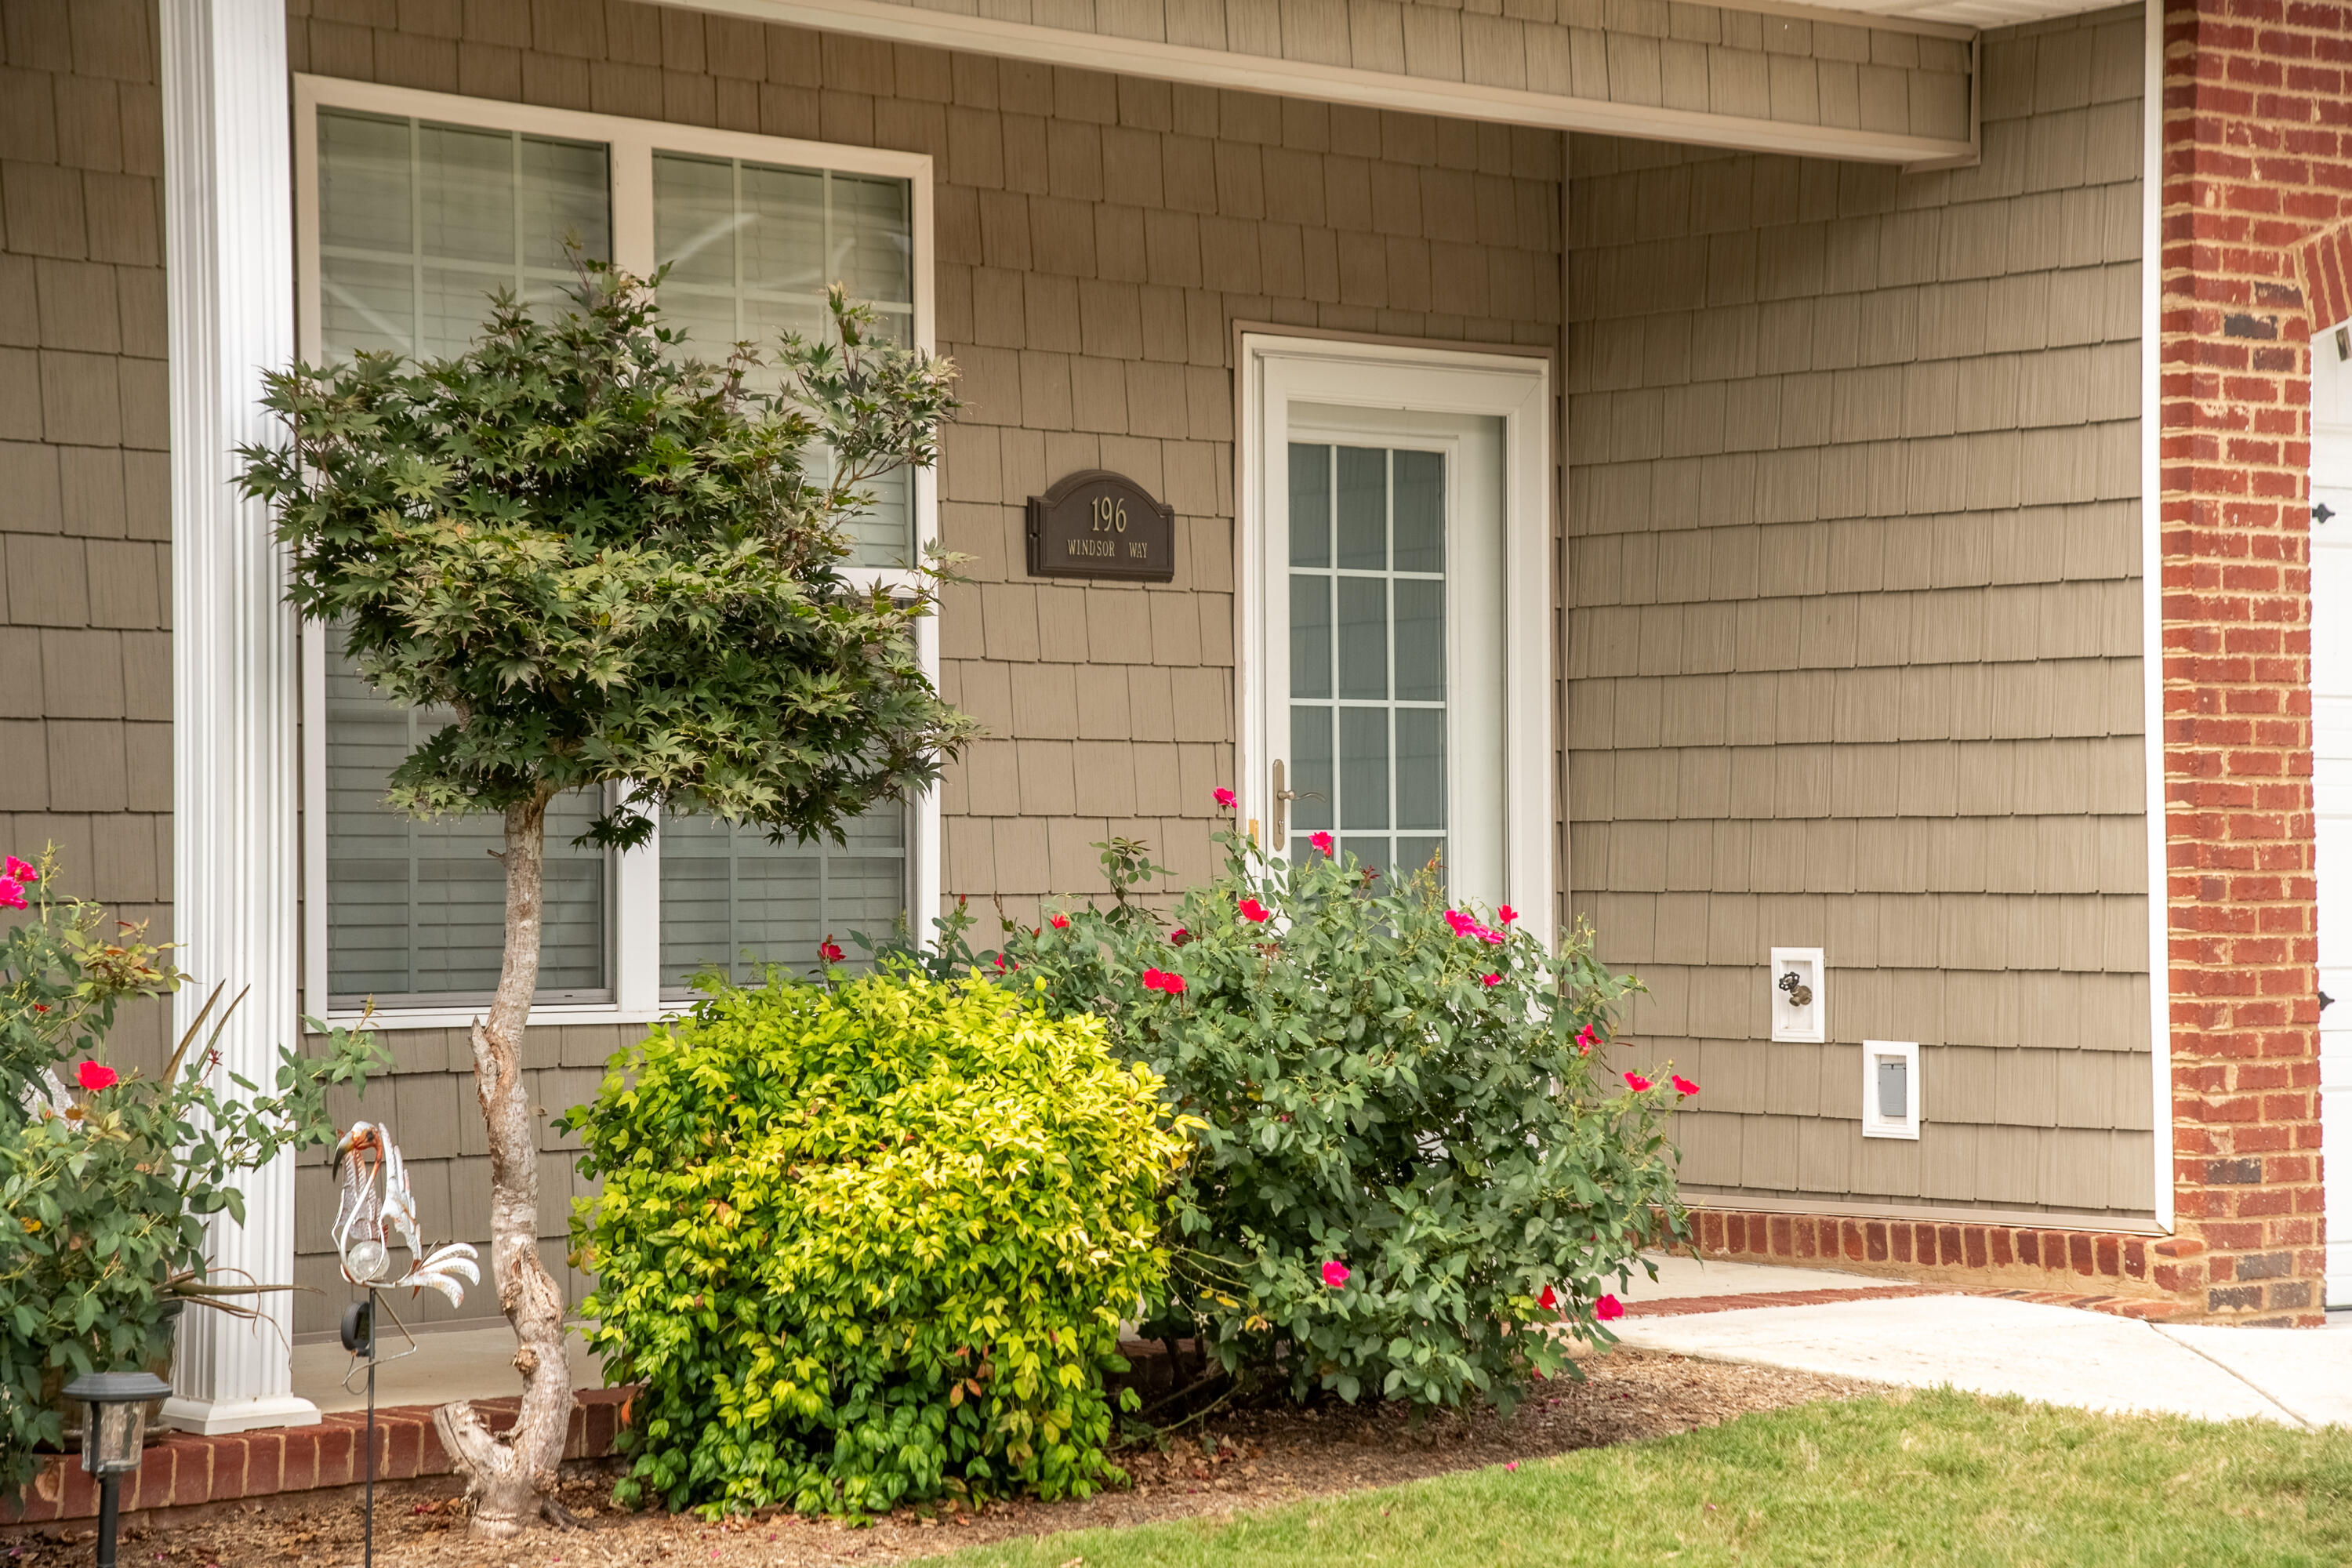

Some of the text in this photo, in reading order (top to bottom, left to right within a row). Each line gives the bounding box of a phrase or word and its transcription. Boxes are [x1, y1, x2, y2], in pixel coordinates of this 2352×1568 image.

[1091, 496, 1127, 533] 196
[1067, 539, 1148, 558] WINDSOR WAY
